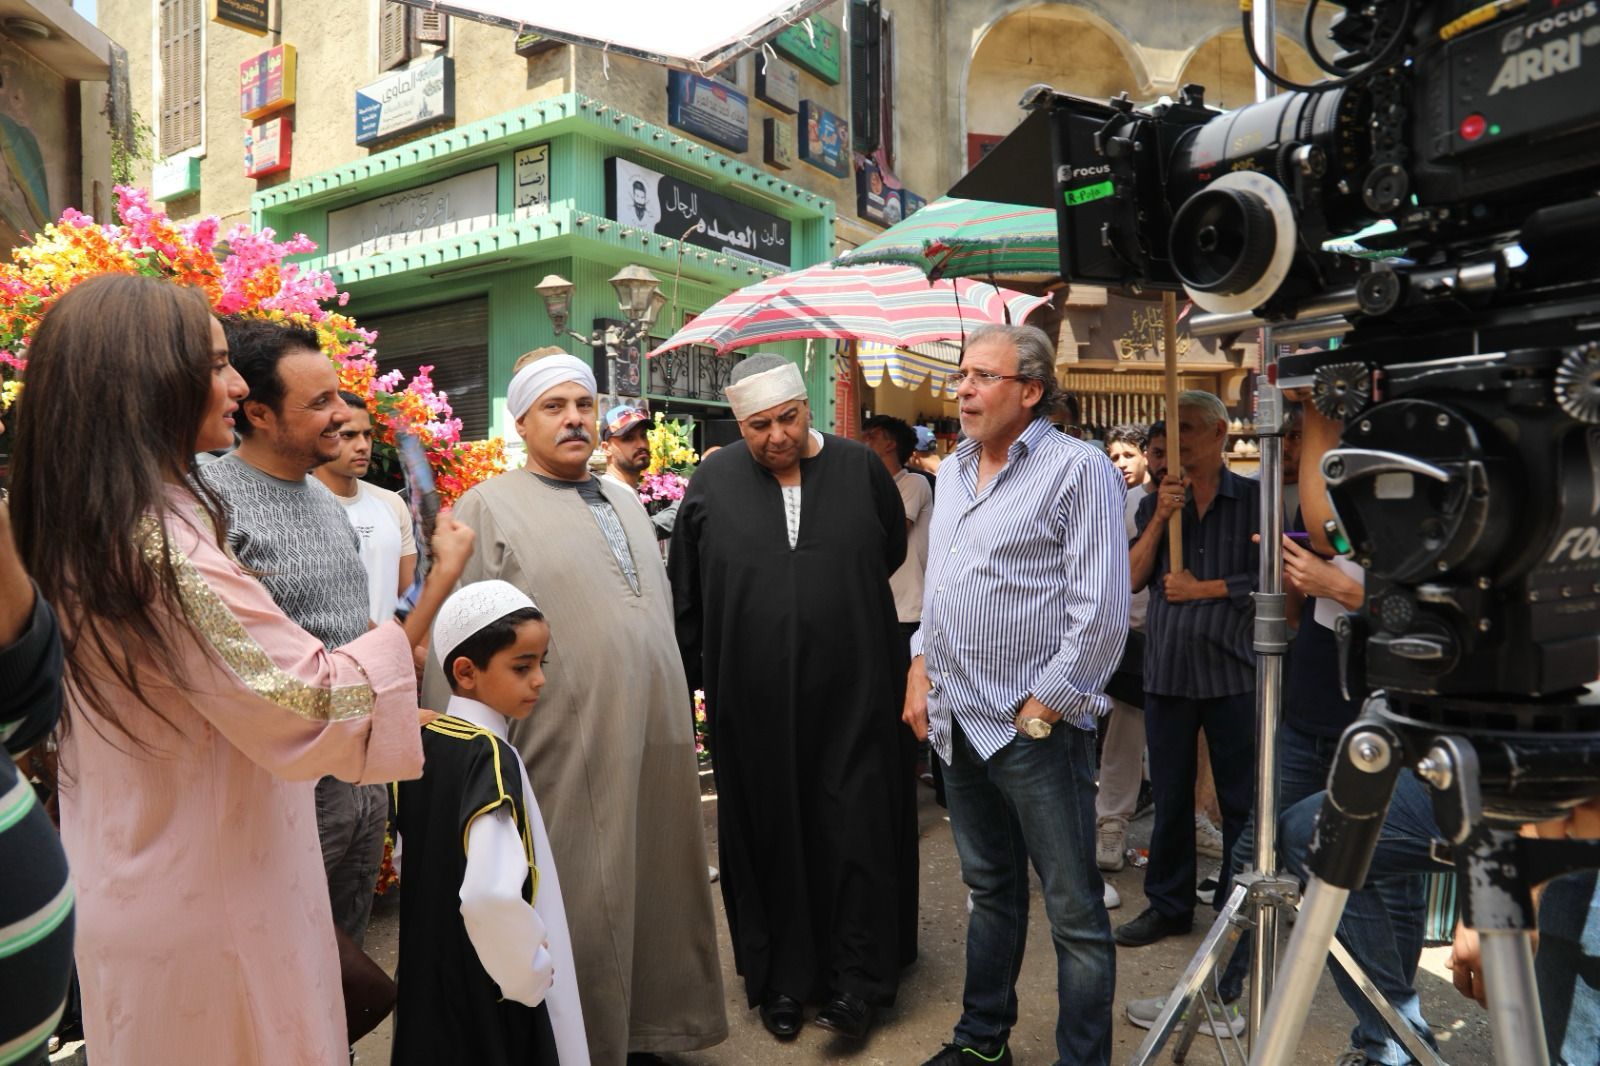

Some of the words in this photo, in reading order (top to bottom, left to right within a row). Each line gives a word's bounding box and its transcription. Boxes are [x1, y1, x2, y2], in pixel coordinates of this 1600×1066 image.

[1487, 32, 1581, 96] ARRI
[519, 148, 546, 167] كده
[518, 171, 545, 187] رضا
[665, 185, 698, 219] للرجال
